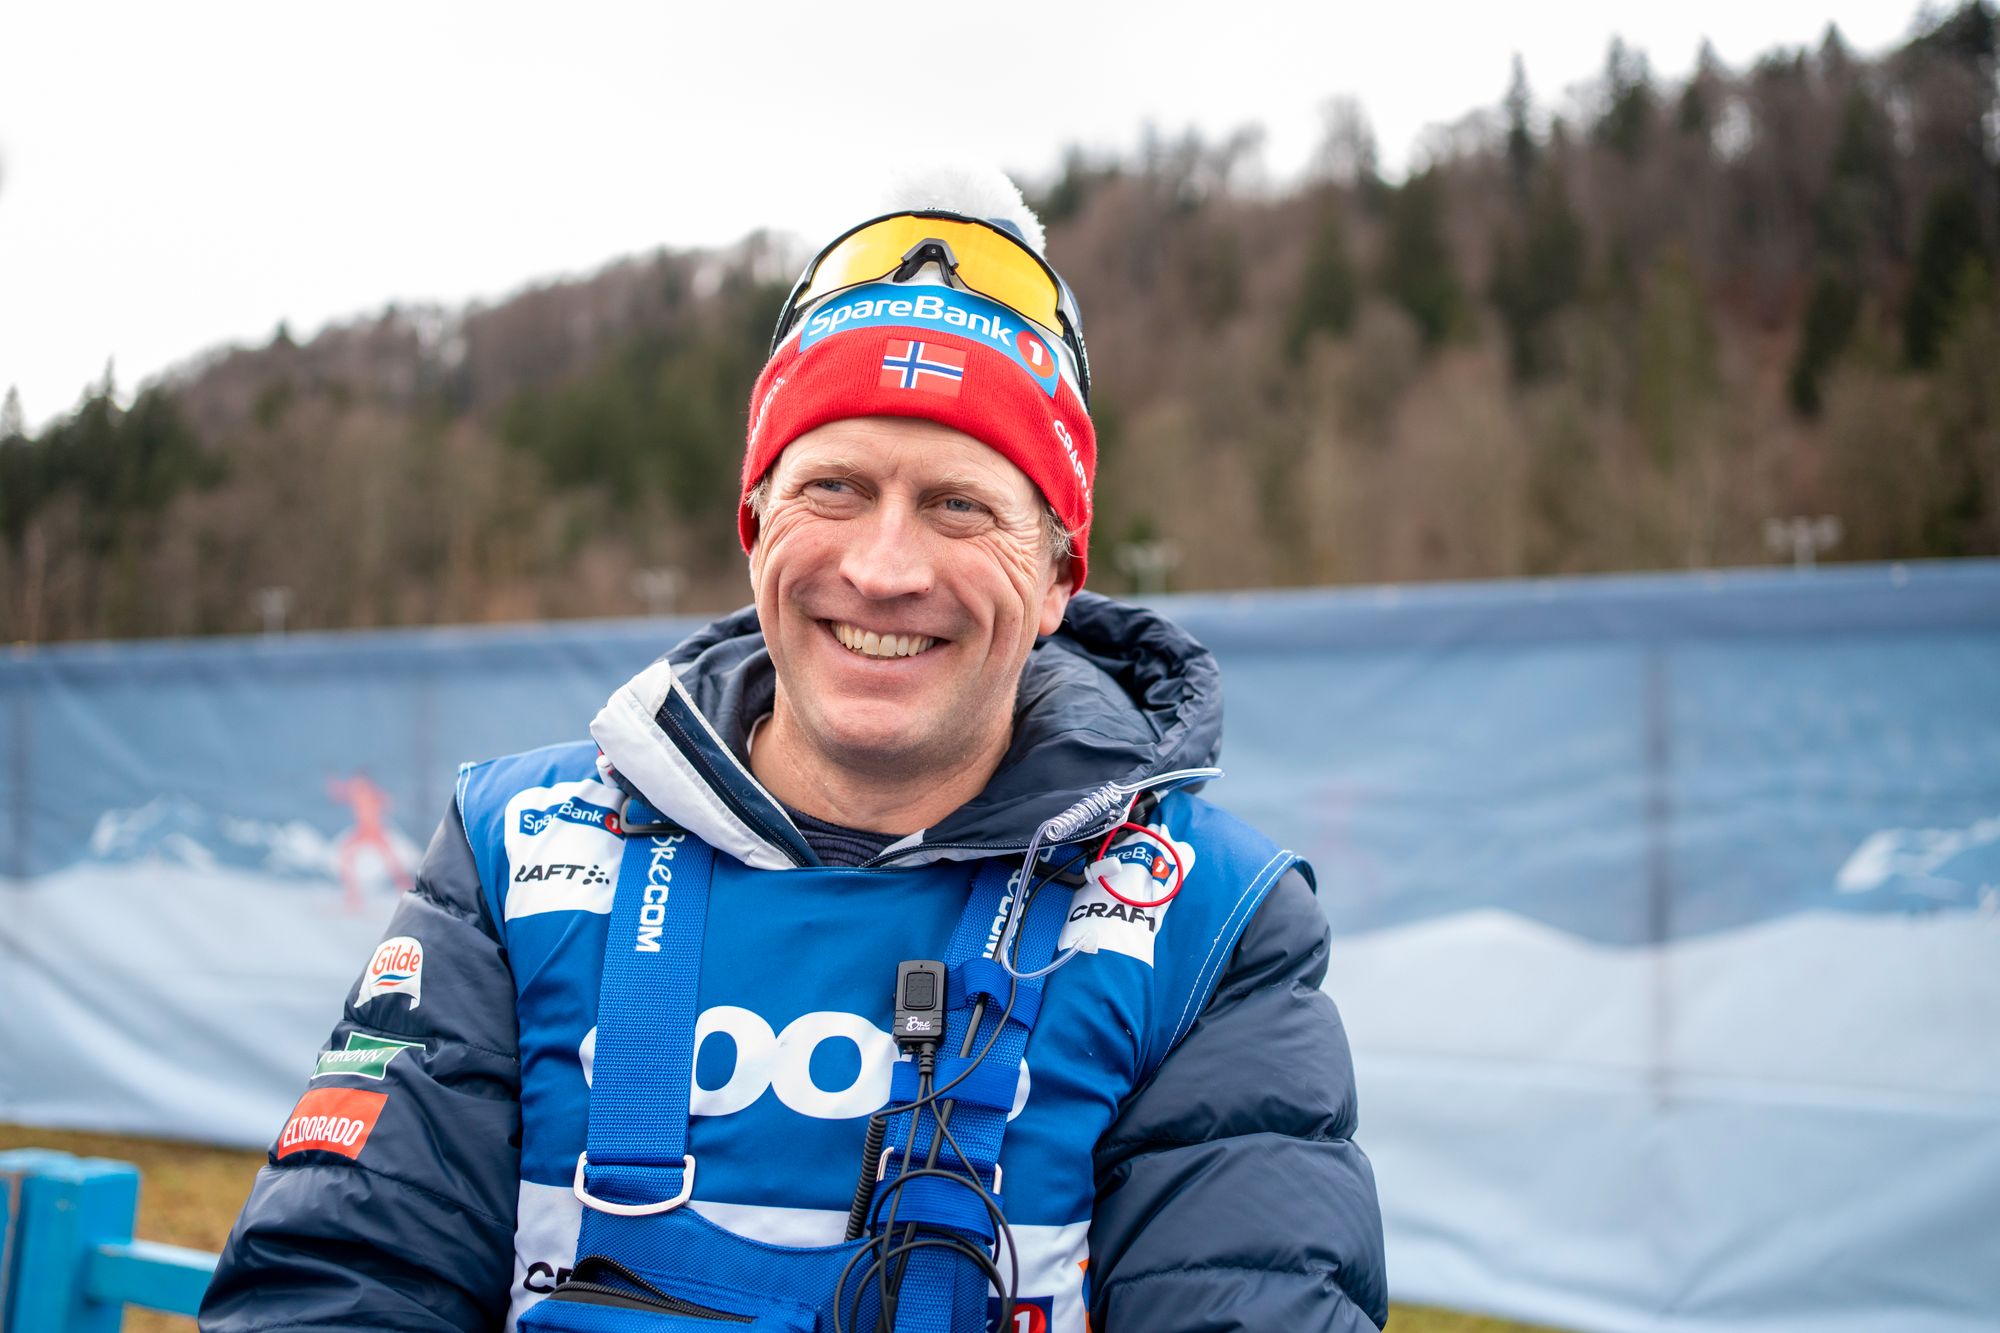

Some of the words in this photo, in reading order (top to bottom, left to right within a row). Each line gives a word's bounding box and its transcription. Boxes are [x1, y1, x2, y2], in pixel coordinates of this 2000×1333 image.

[808, 295, 1012, 347] SpareBank
[1028, 339, 1044, 367] 1
[1053, 419, 1087, 489] CRAFT
[372, 944, 420, 976] Gilde
[283, 1115, 365, 1147] ELDORADO
